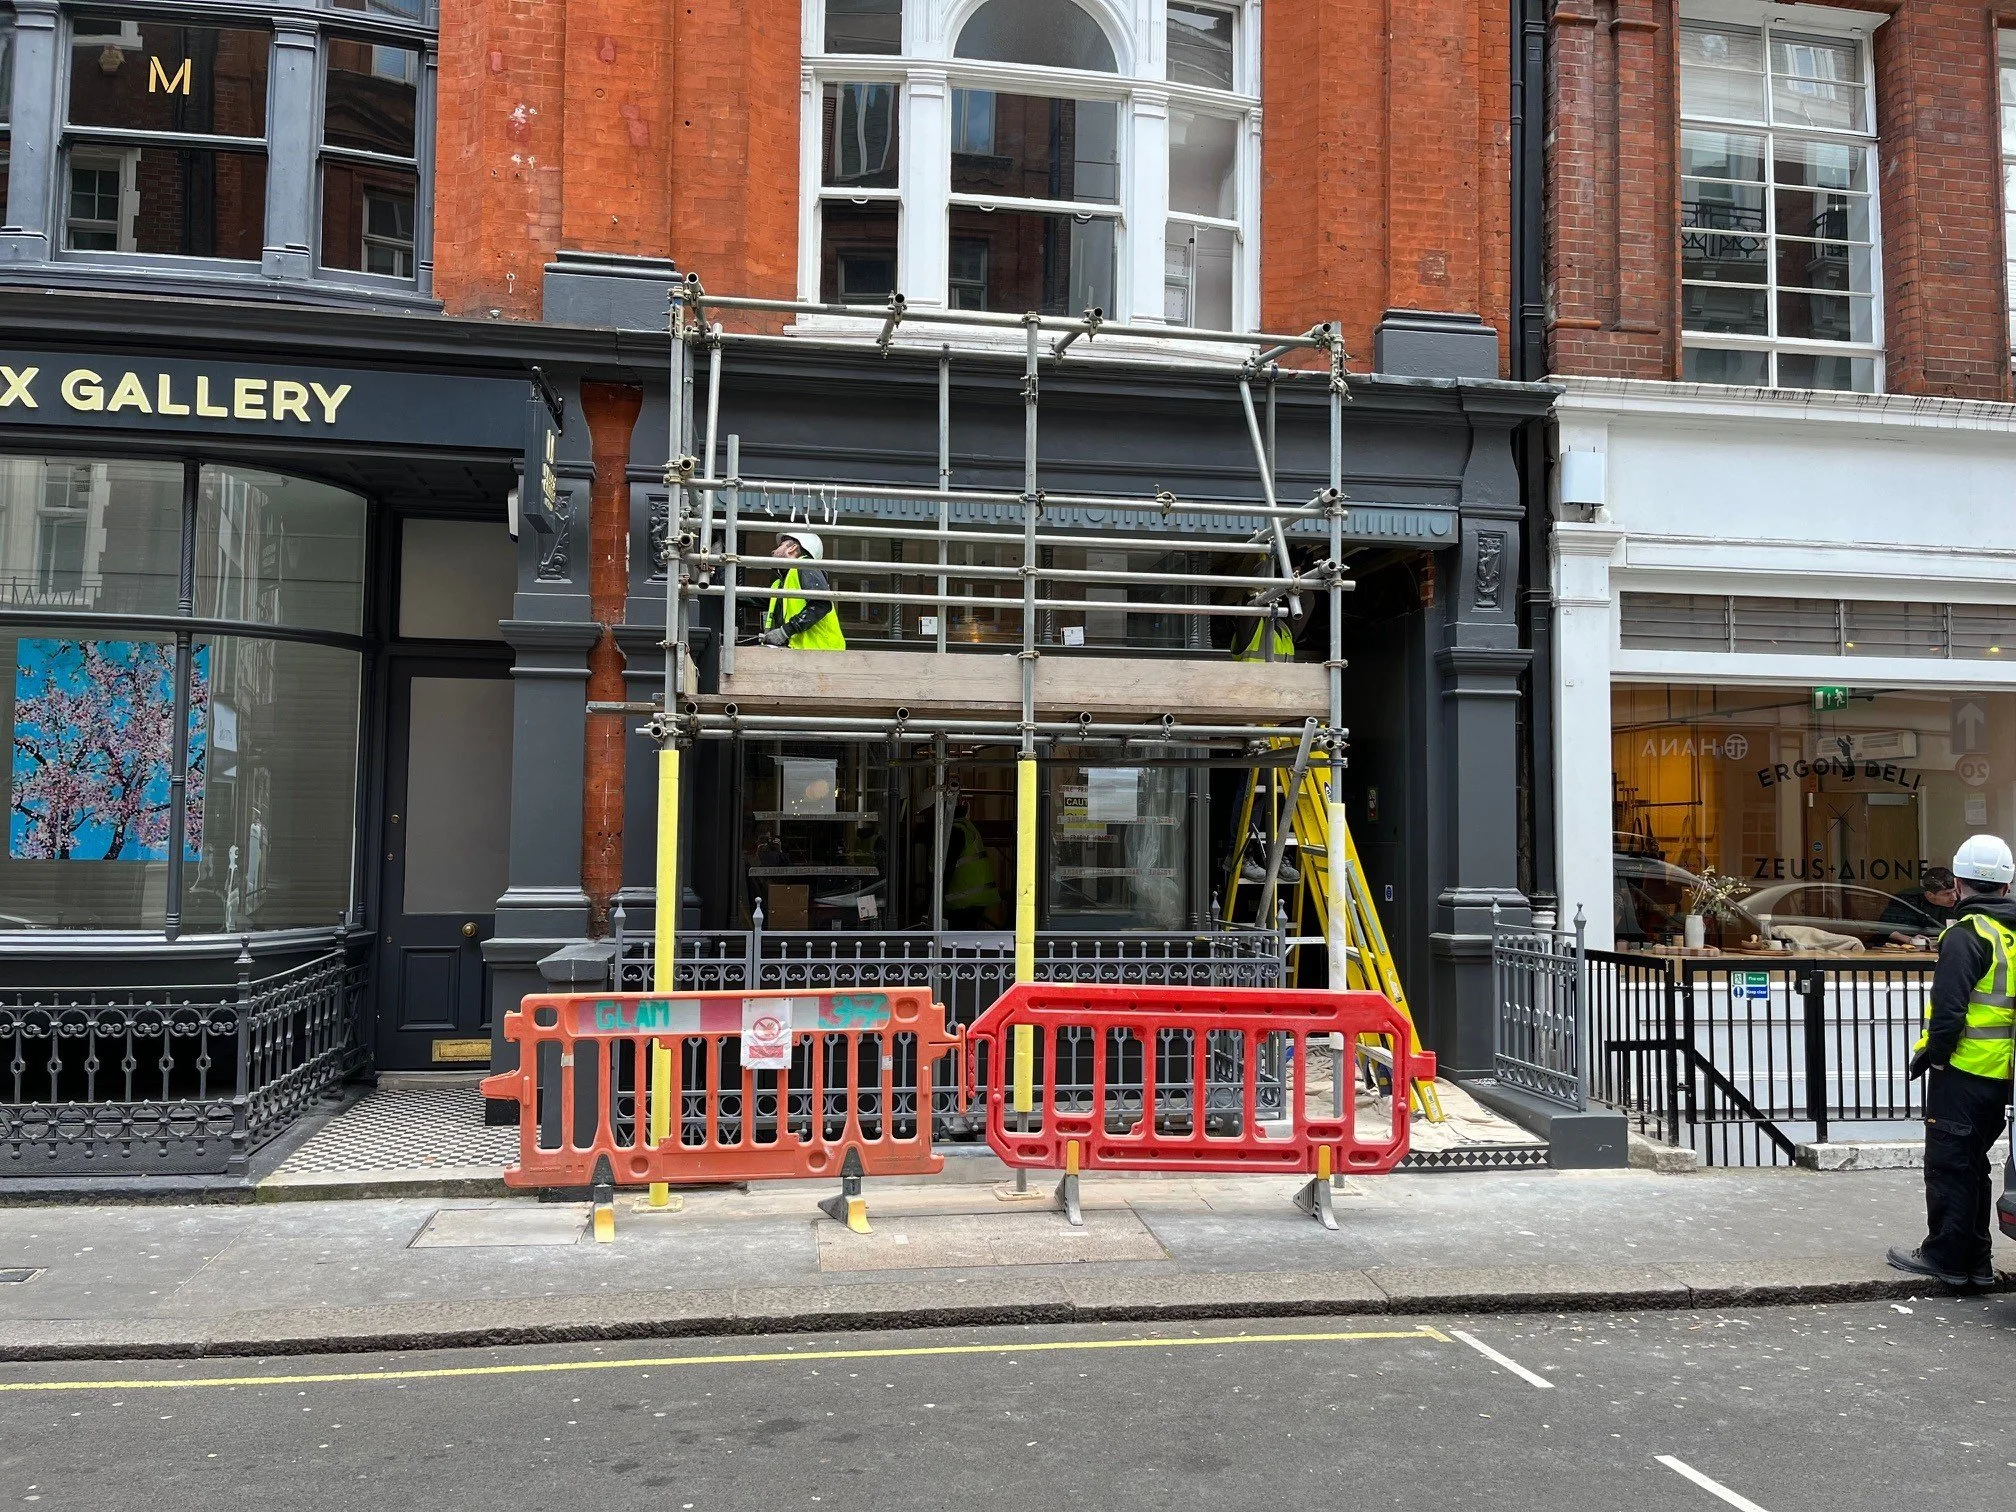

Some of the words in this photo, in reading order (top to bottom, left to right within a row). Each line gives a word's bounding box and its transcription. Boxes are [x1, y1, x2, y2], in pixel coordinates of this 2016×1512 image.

[148, 56, 192, 96] M
[0, 365, 40, 408] X
[61, 368, 352, 424] GALLERY
[1756, 756, 1854, 788] ERGON
[1864, 759, 1922, 790] DELI
[595, 999, 670, 1029] GLAM
